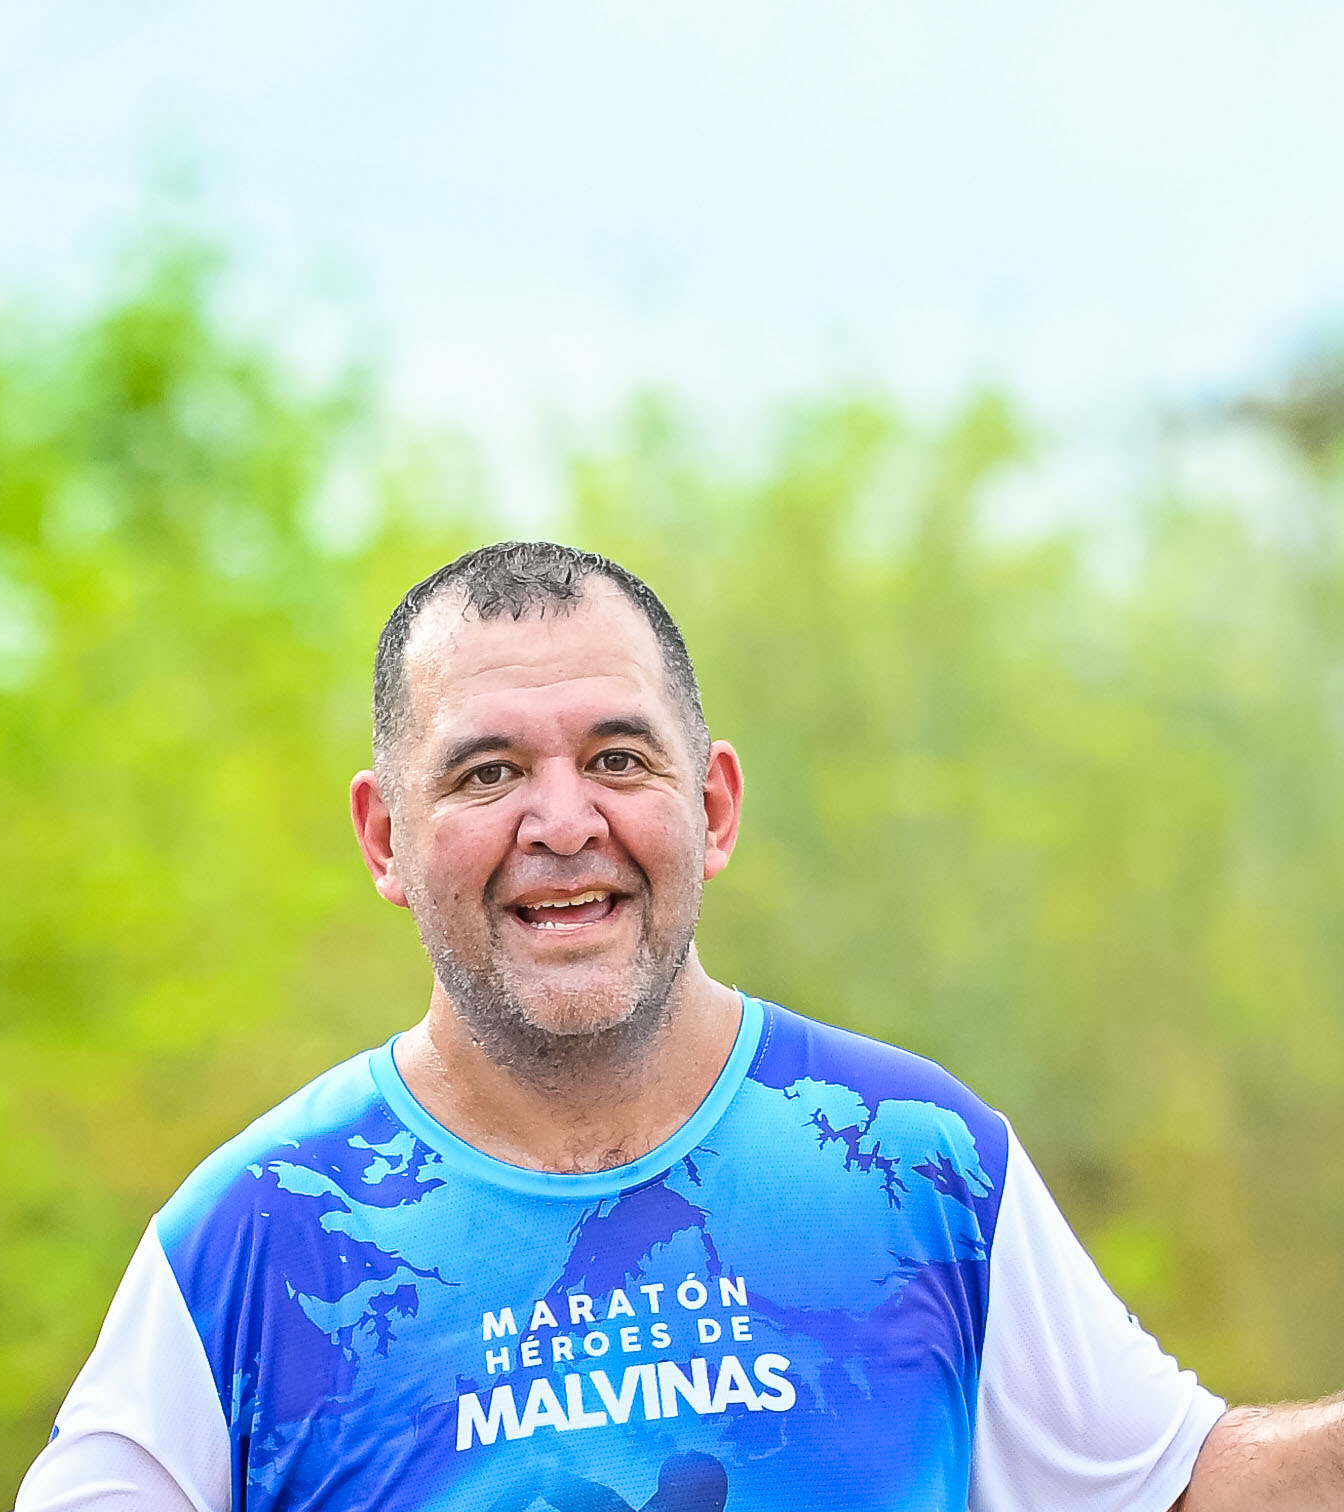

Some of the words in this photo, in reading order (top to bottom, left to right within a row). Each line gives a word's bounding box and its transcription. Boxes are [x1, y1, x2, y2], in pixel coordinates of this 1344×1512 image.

[482, 1273, 748, 1341] MARATÓN
[485, 1322, 672, 1375] HÉROES
[697, 1316, 753, 1344] DE
[455, 1353, 796, 1451] MALVINAS
